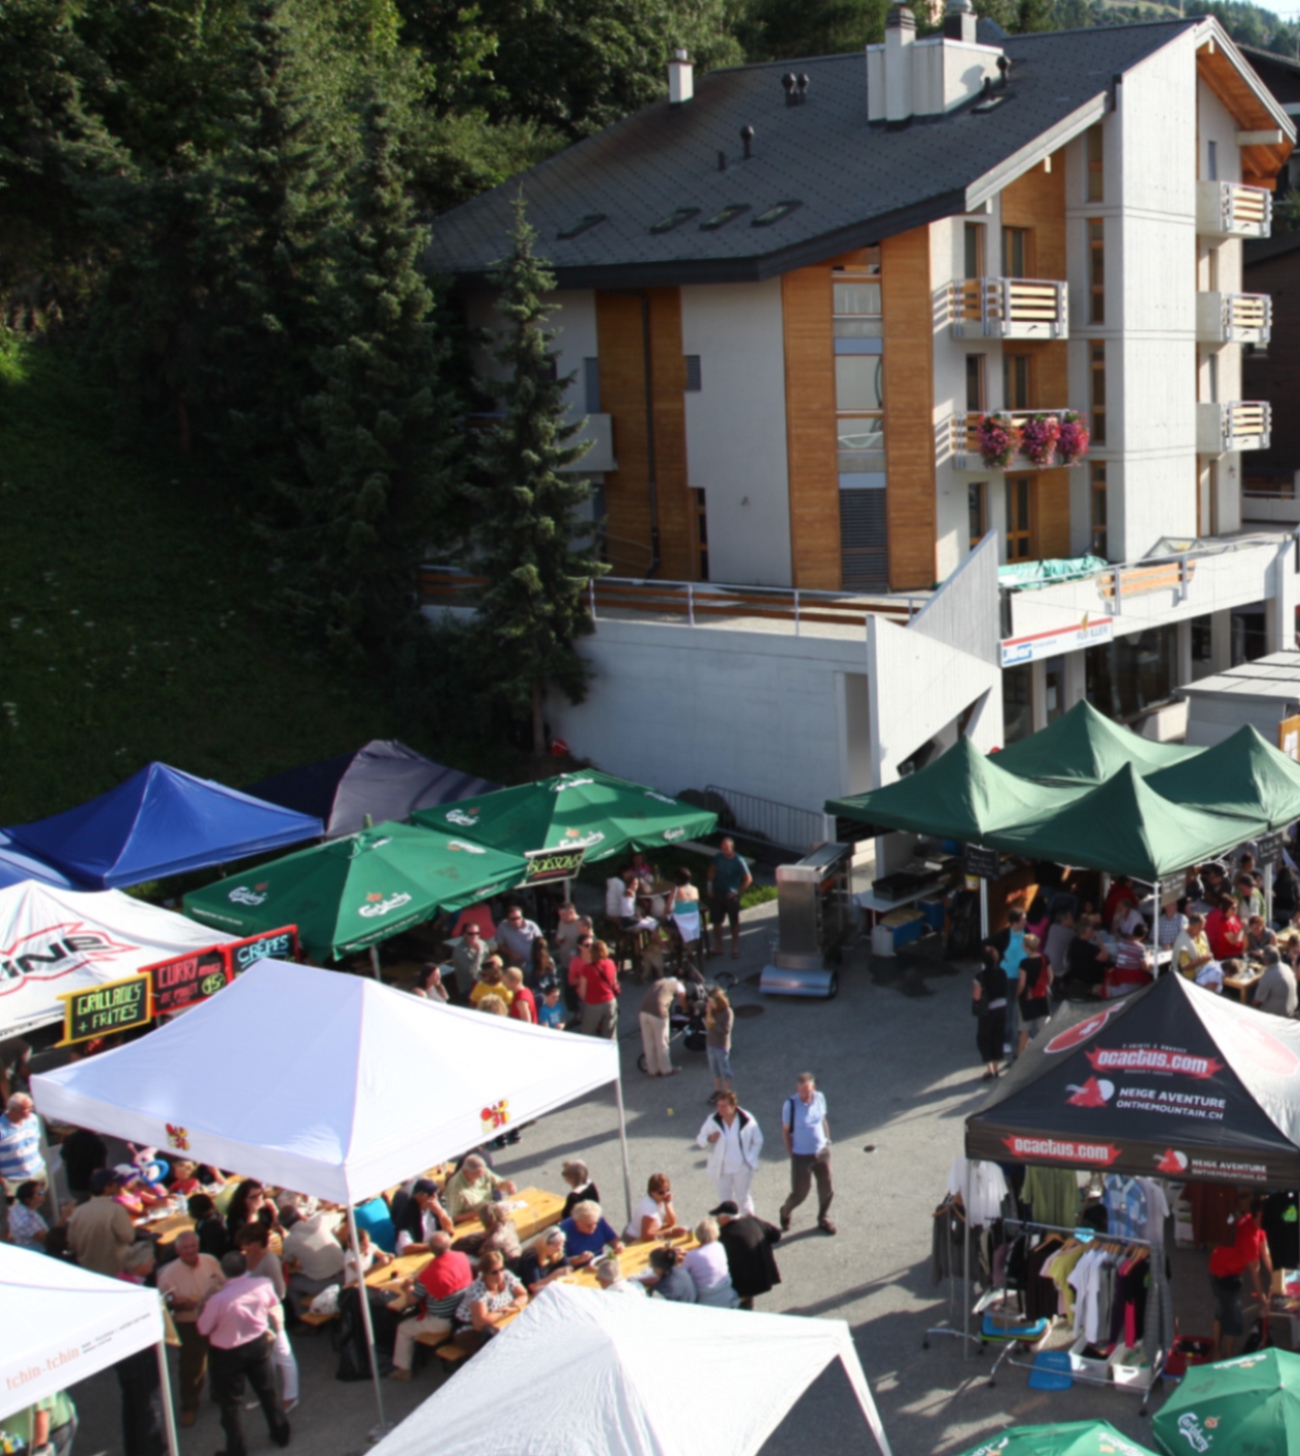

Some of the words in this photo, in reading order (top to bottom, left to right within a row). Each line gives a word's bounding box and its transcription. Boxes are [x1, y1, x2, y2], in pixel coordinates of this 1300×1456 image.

[358, 892, 412, 918] Carlsberg
[157, 957, 199, 989] CURRY
[92, 1003, 138, 1029] FRITES
[1097, 1049, 1208, 1074] ocactus.com
[1116, 1100, 1224, 1120] ONTHEMOUNTAIN.CH
[1119, 1087, 1156, 1100] NEIGE
[1158, 1091, 1226, 1109] AVENTURE
[1014, 1138, 1109, 1161] ocactus.com
[1192, 1158, 1217, 1169] NEIGE
[1219, 1161, 1267, 1173] AVENTURE
[6, 1347, 80, 1390] tchin-tchin
[1177, 1412, 1210, 1453] Carlsberg
